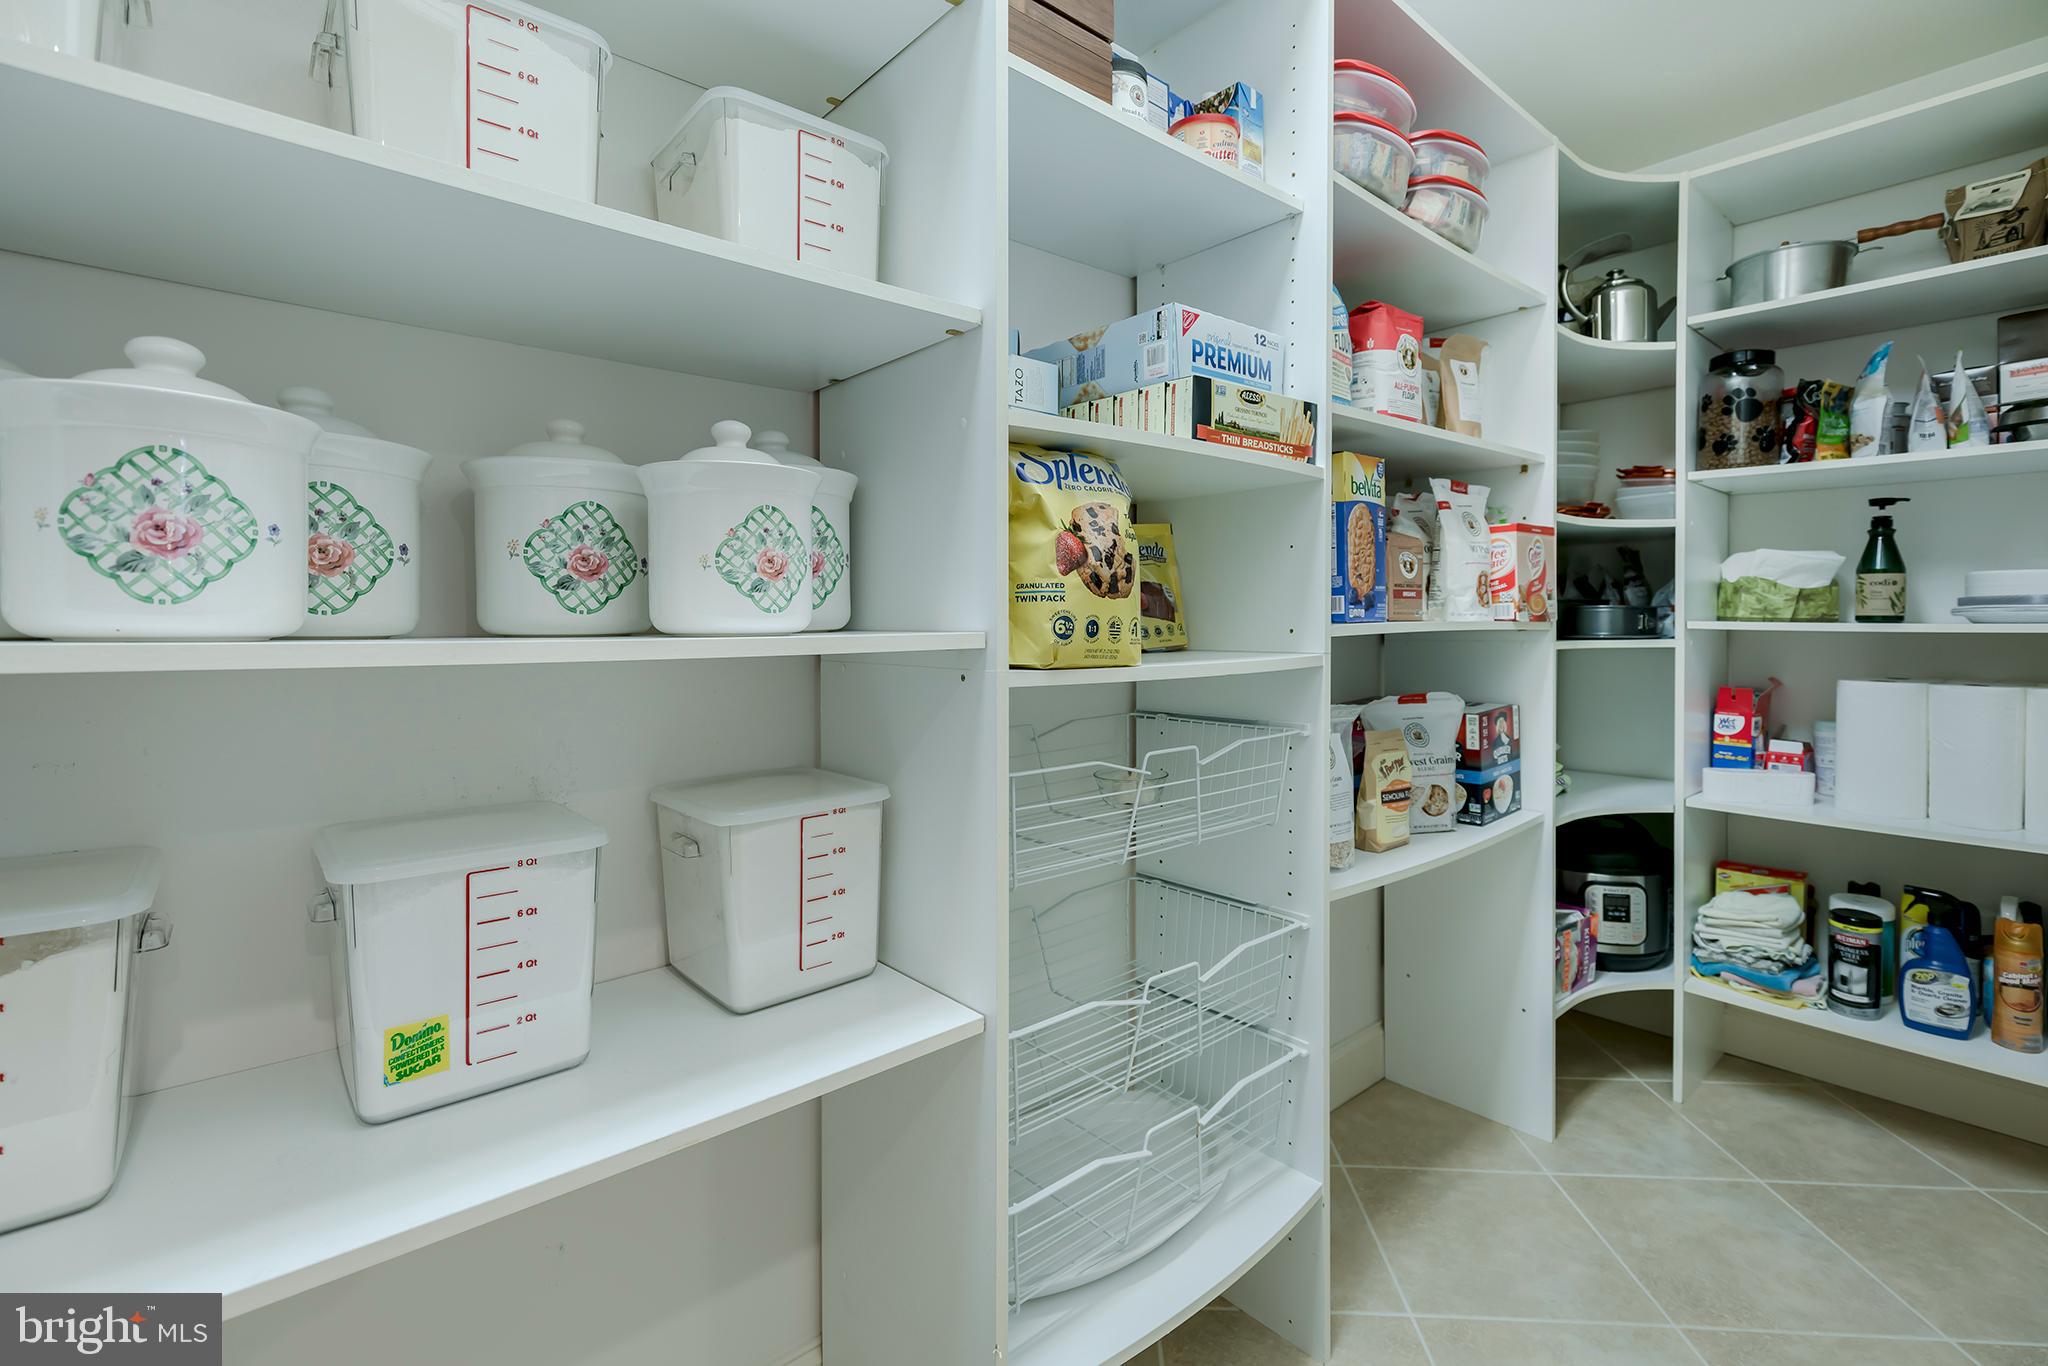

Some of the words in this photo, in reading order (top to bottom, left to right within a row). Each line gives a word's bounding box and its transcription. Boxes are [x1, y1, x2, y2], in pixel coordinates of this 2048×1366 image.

[518, 18, 525, 28] 8
[526, 21, 539, 34] Qt
[518, 71, 525, 80] 6
[527, 74, 539, 86] Qt
[518, 126, 525, 135] 4
[527, 129, 539, 140] Qt
[836, 180, 845, 190] Qt
[836, 225, 845, 234] Qt
[1253, 332, 1267, 348] 12
[1191, 338, 1272, 383] PREMIUM
[1015, 368, 1024, 404] TAZO
[1221, 433, 1241, 447] THIN
[1242, 438, 1295, 455] BREADSTICKS
[1064, 482, 1082, 491] ZERO
[1083, 485, 1114, 493] CALORIE
[1350, 472, 1382, 499] belVita
[1138, 542, 1165, 557] enda
[1016, 582, 1066, 590] GRANULATED
[1015, 595, 1038, 604] TWIN
[1040, 594, 1067, 603] PACK
[1088, 625, 1098, 633] 1:1
[1429, 755, 1455, 766] Grain
[838, 807, 846, 815] Qt
[838, 846, 846, 854] Qt
[525, 857, 538, 867] Qt
[837, 888, 846, 896] Qt
[517, 909, 524, 917] 6
[526, 907, 538, 917] Qt
[837, 931, 845, 939] Qt
[517, 961, 523, 969] 4
[525, 958, 538, 968] Qt
[516, 1017, 523, 1025] 2
[525, 1013, 537, 1023] Qt
[391, 1022, 442, 1052] Domino
[389, 1036, 445, 1066] CONFECTIONERS
[390, 1051, 430, 1073] POWDERED
[395, 1054, 441, 1081] SUGAR
